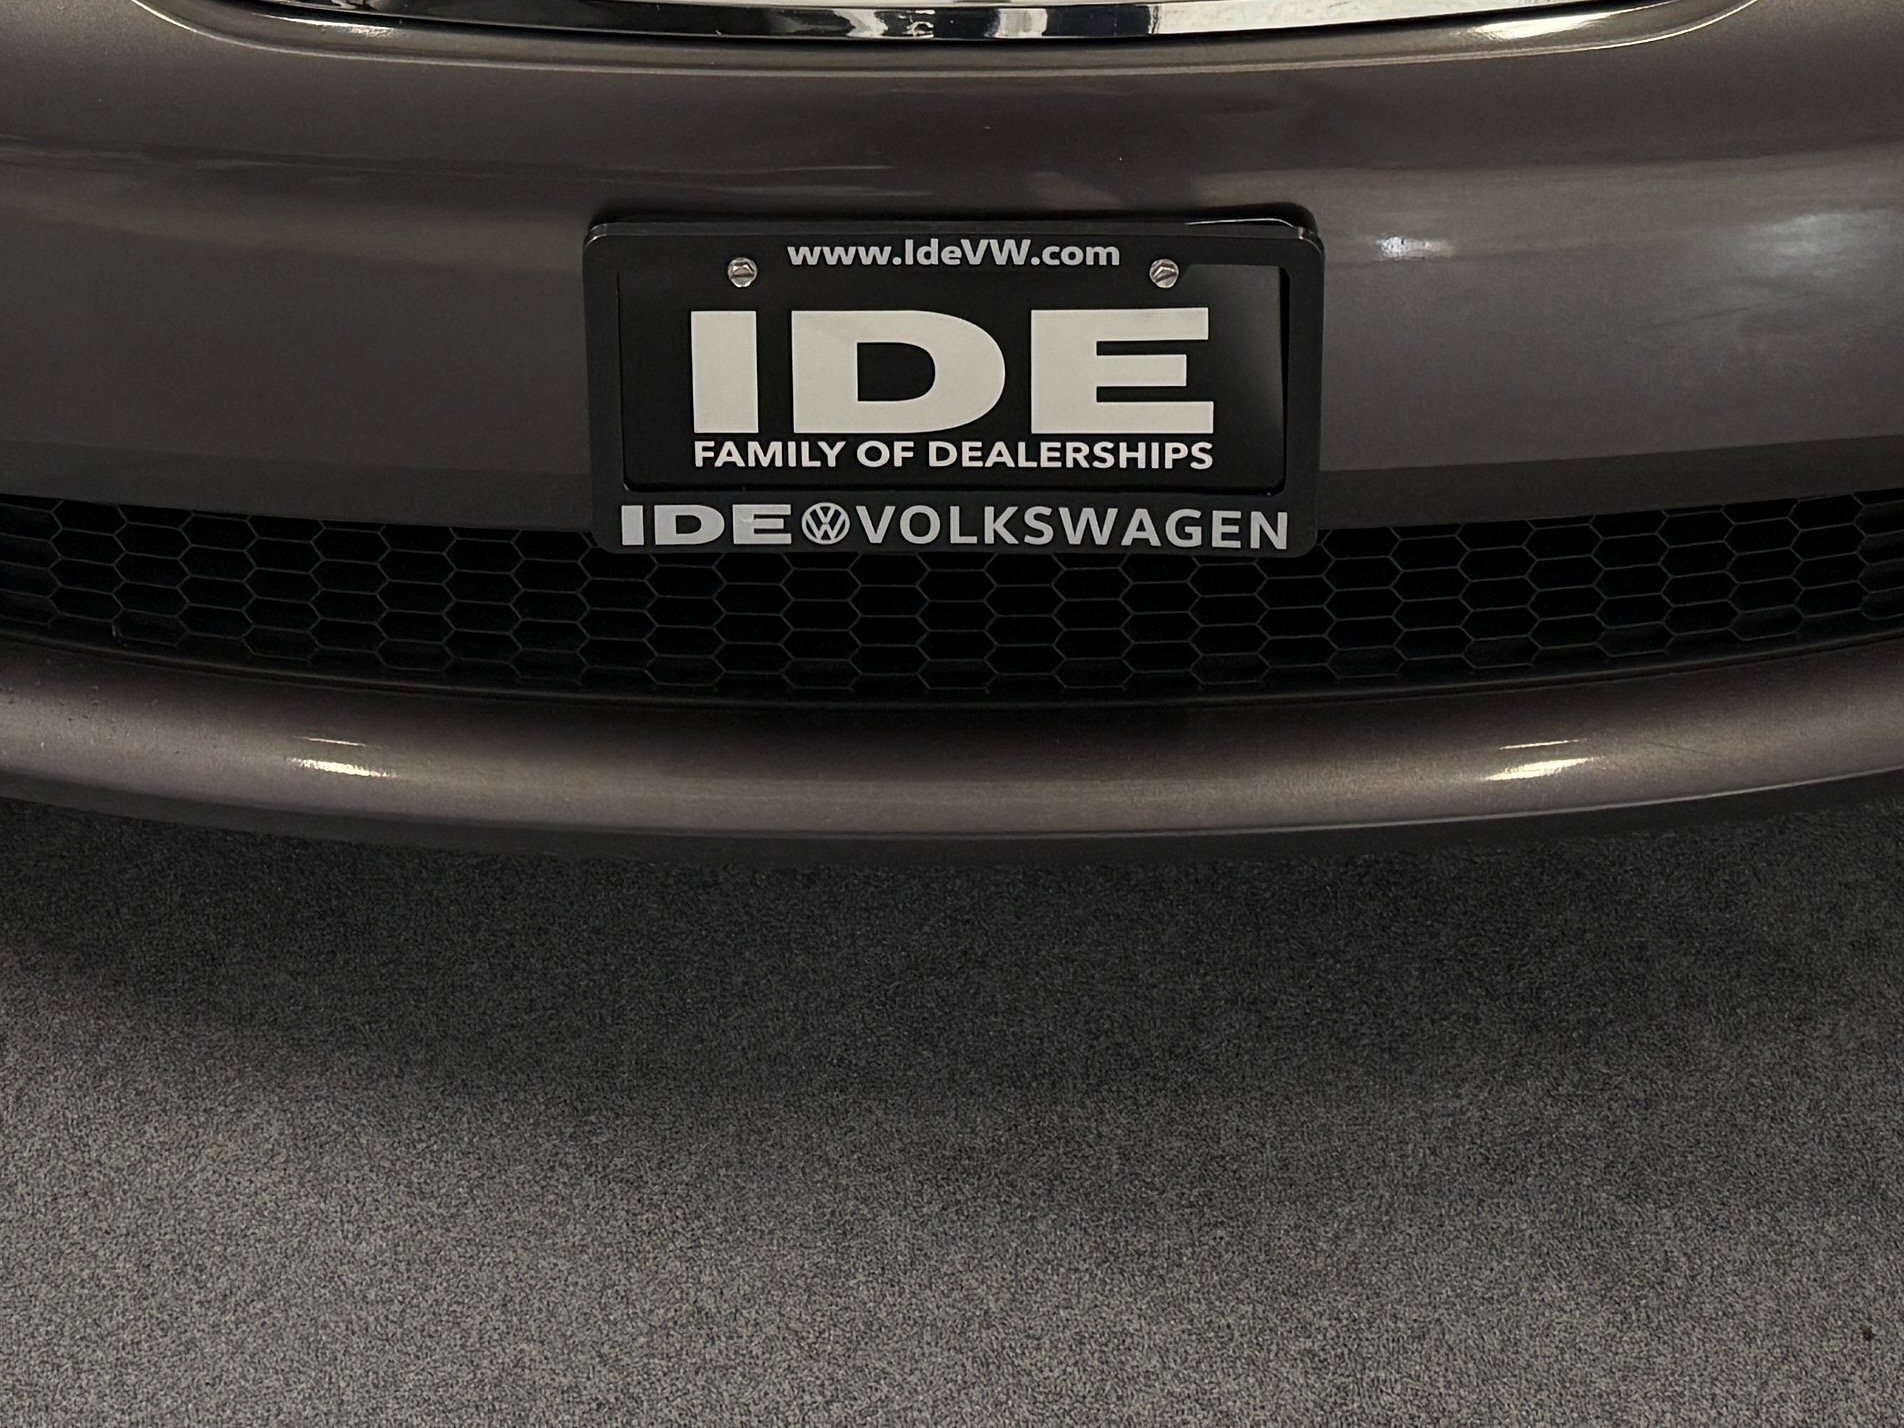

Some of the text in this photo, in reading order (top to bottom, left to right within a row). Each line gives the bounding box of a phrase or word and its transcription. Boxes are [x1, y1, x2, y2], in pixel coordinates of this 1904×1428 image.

[787, 237, 1120, 266] www.IdeVW.com
[690, 306, 1215, 435] IDE
[694, 440, 1214, 470] FAMILY OF DEALERSHIPS
[621, 503, 792, 546] IDE
[855, 504, 1289, 550] VOLKSWAGEN
